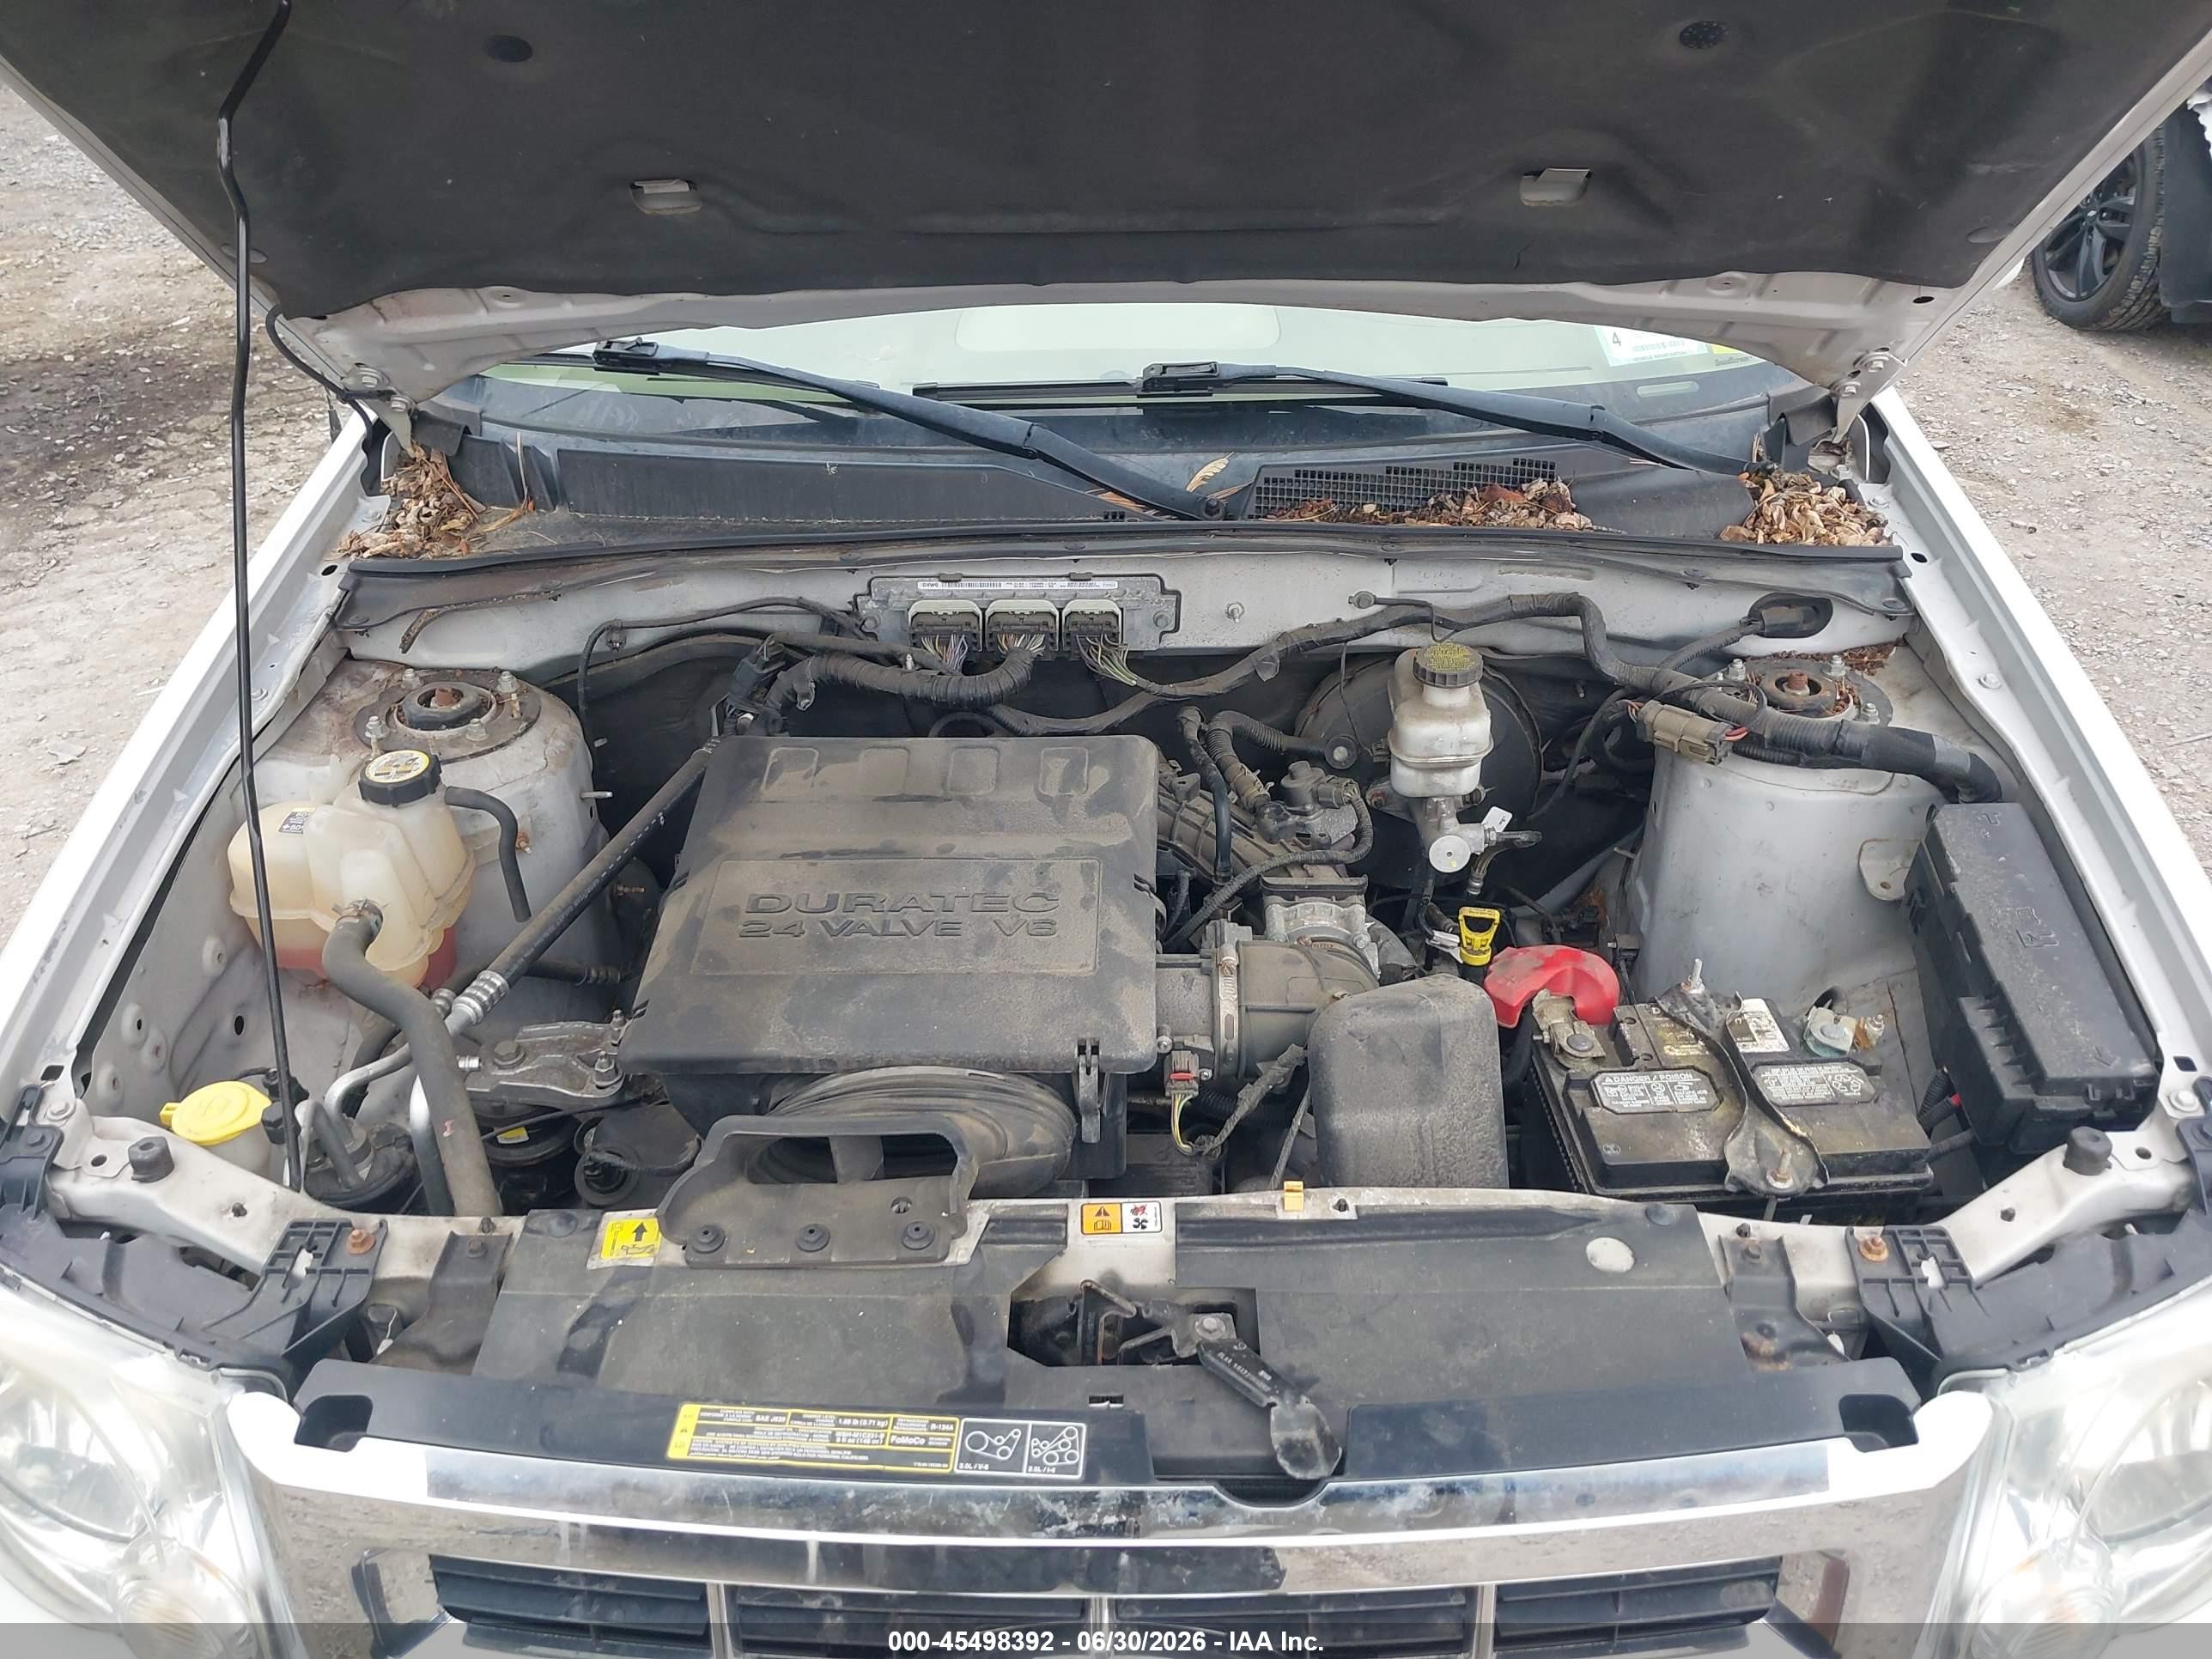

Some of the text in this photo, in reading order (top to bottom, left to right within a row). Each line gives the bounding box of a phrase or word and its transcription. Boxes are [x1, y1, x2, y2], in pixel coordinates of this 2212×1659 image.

[744, 892, 1059, 914] DURATEC
[738, 919, 1058, 938] 24 VALVE V6
[1659, 1073, 1693, 1081] POISON
[890, 1435, 926, 1445] FoMoCo
